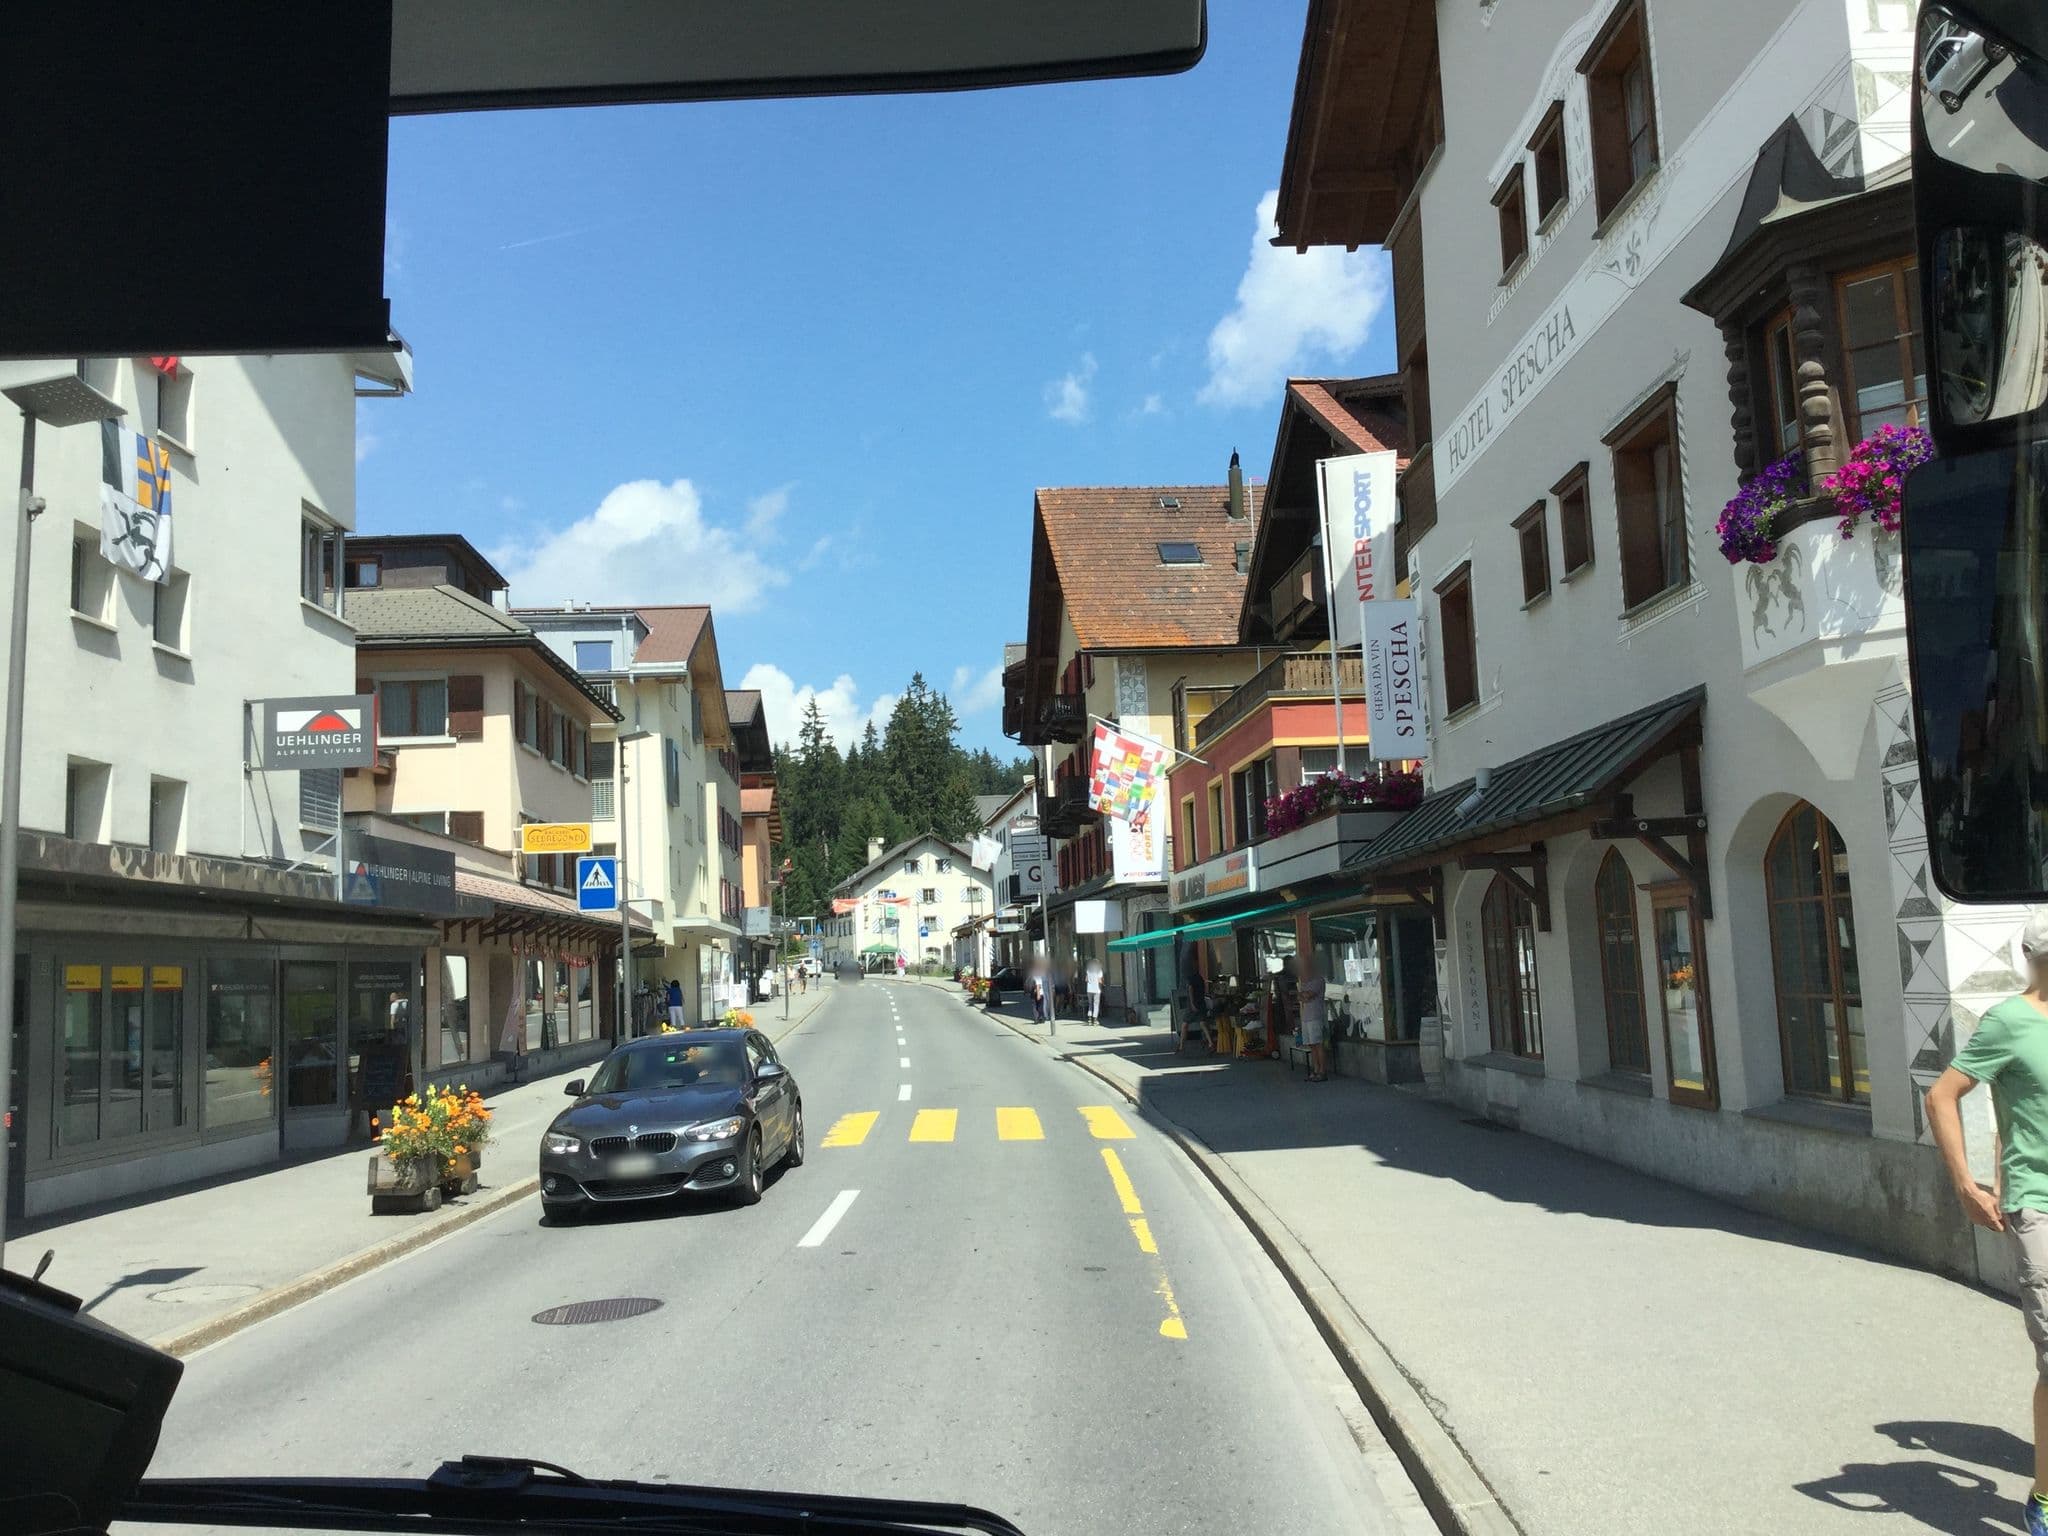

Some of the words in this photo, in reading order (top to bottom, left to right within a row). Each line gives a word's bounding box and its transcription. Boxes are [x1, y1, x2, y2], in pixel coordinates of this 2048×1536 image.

[1448, 397, 1494, 474] HOTEL
[1500, 304, 1576, 414] SPESCHA
[1353, 470, 1375, 602] NTERSPORT
[1370, 638, 1381, 660] VIN
[1373, 661, 1383, 683] DA
[1390, 620, 1415, 737] SPESCHA
[1374, 683, 1385, 721] CHESA
[276, 733, 362, 747] UEHLINGER
[369, 864, 408, 881] UEHLINGER
[412, 871, 432, 885] ALPINE
[433, 873, 451, 888] LIVING
[1465, 920, 1481, 1032] RESTAURANT
